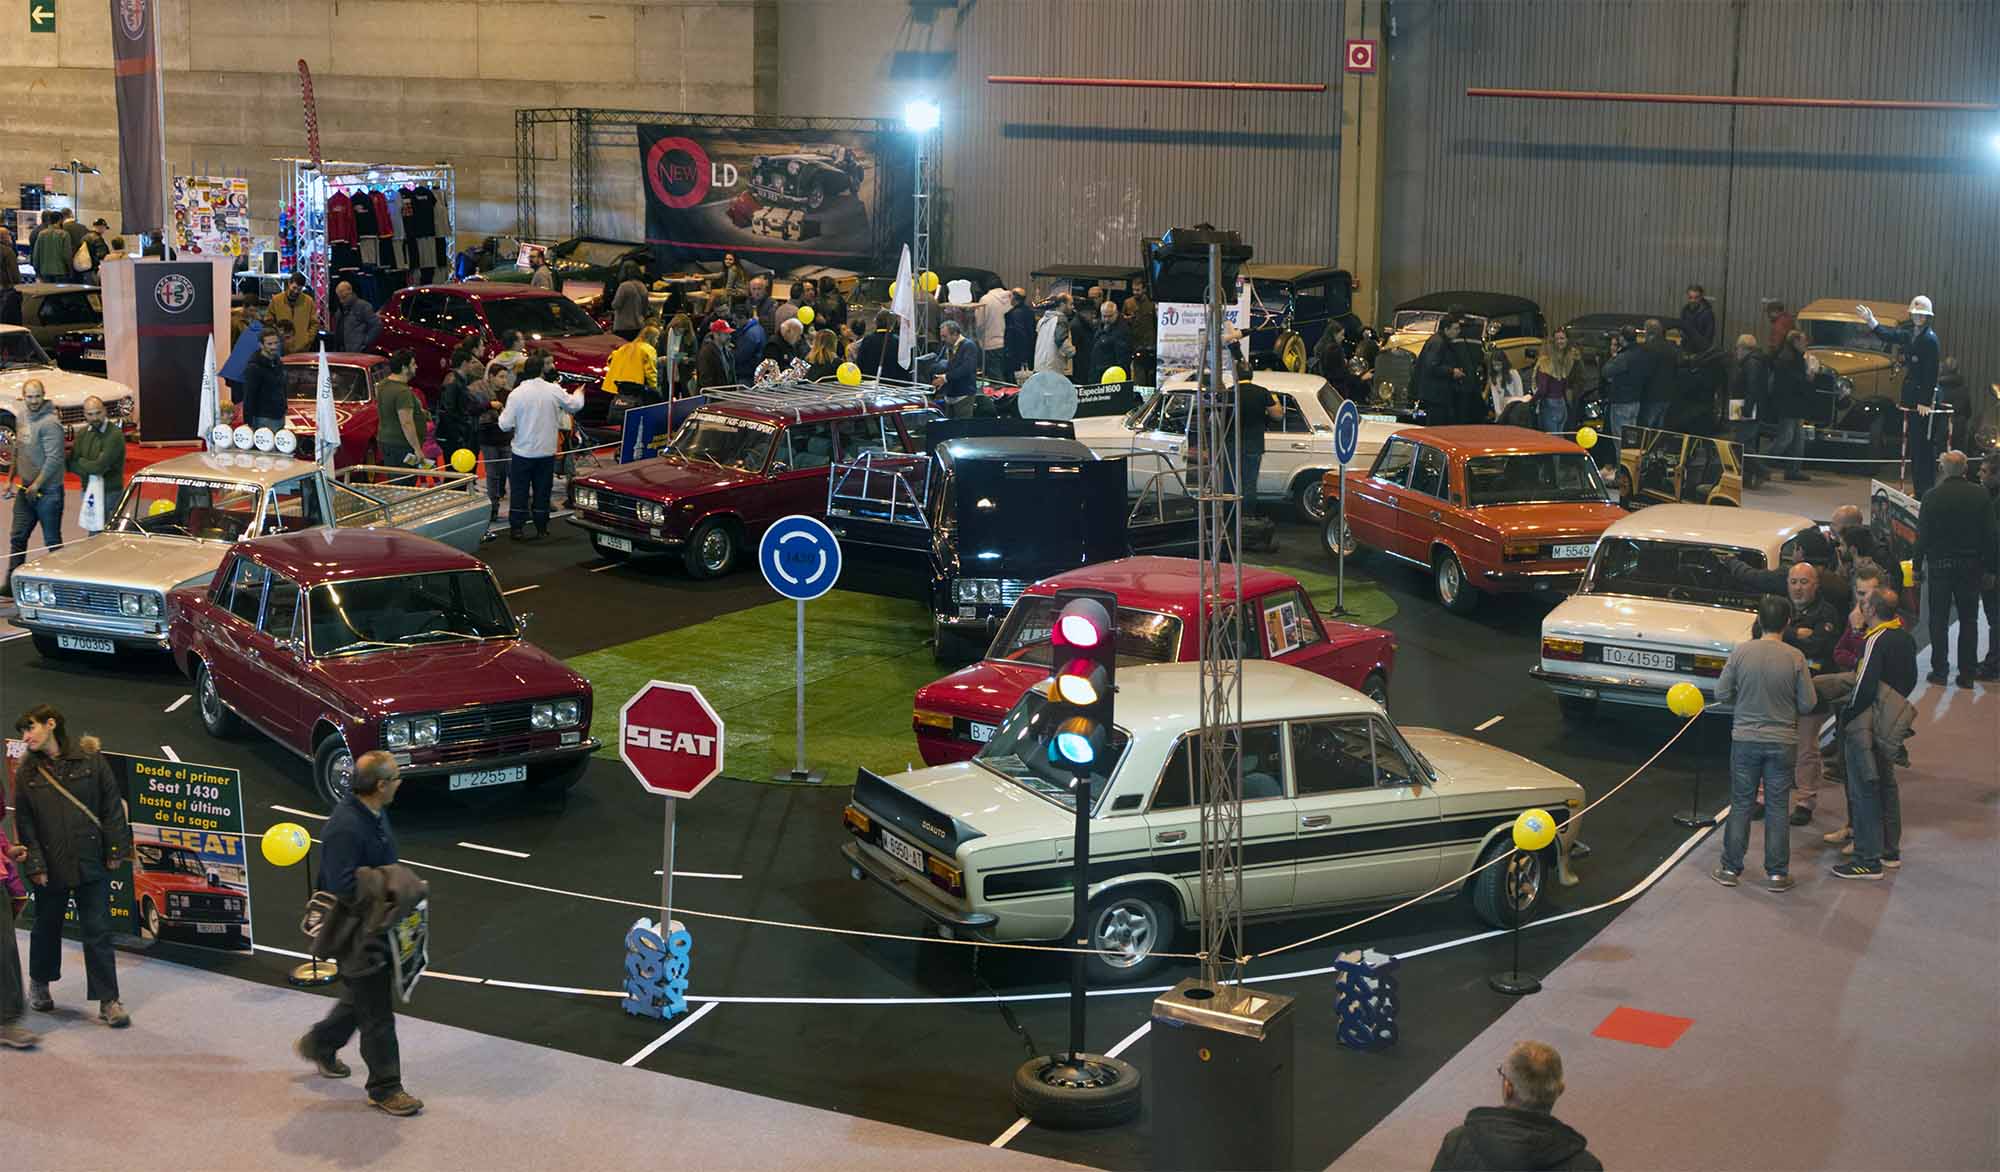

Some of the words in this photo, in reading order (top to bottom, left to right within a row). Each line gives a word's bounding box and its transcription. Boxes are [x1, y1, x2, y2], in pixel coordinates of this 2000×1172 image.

[658, 161, 698, 185] NEW
[1078, 386, 1104, 397] Especial
[1105, 384, 1121, 394] 1600
[627, 724, 716, 757] SEAT
[136, 763, 172, 778] Desde
[175, 768, 187, 780] el
[190, 772, 231, 785] primer
[148, 778, 181, 794] Seat
[186, 783, 219, 800] 1430
[139, 793, 172, 808] hasta
[175, 800, 187, 810] el
[190, 800, 232, 817] último
[155, 810, 169, 822] de
[173, 812, 185, 824] la
[189, 816, 218, 830] saga
[160, 827, 241, 856] SEAT
